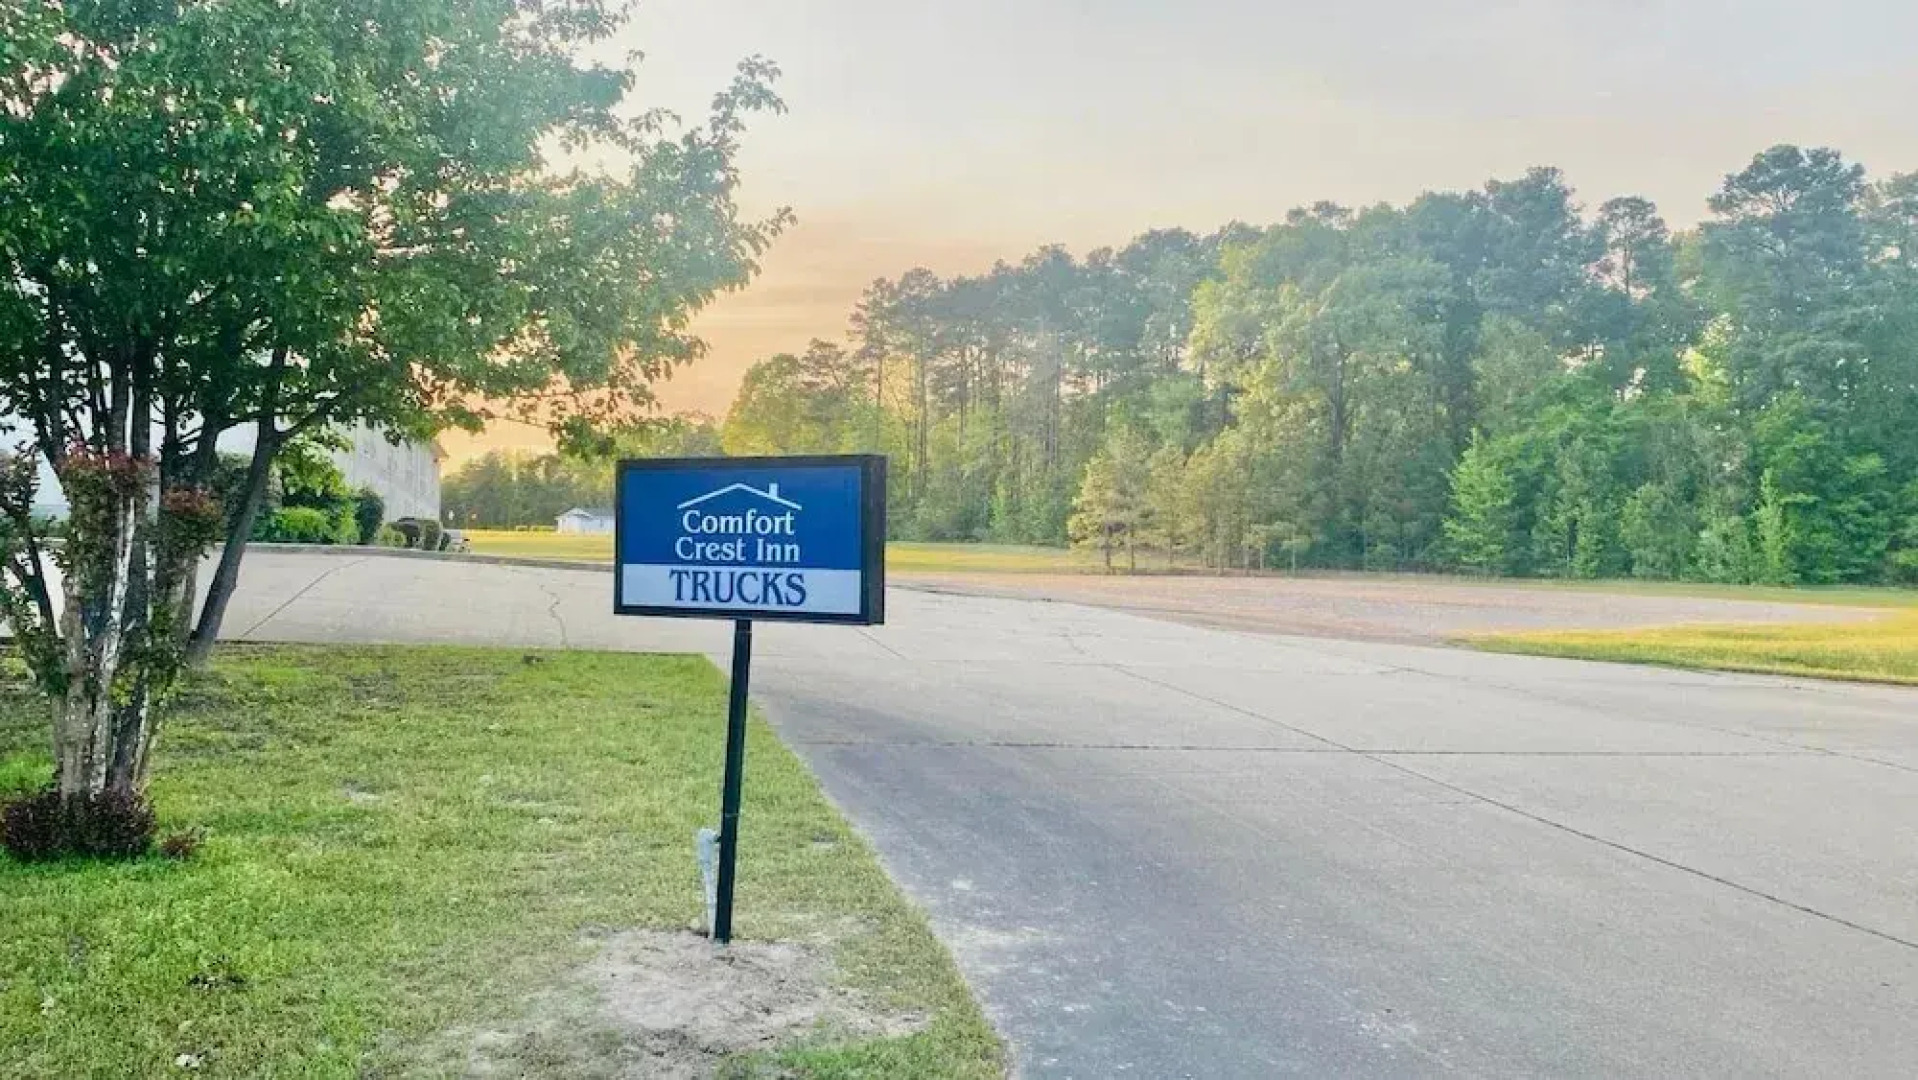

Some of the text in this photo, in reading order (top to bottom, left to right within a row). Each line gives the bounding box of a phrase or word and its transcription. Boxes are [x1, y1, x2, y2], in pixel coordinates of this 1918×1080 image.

[682, 508, 795, 535] Comfort
[675, 536, 800, 563] Crest Inn
[669, 569, 807, 606] TRUCKS
